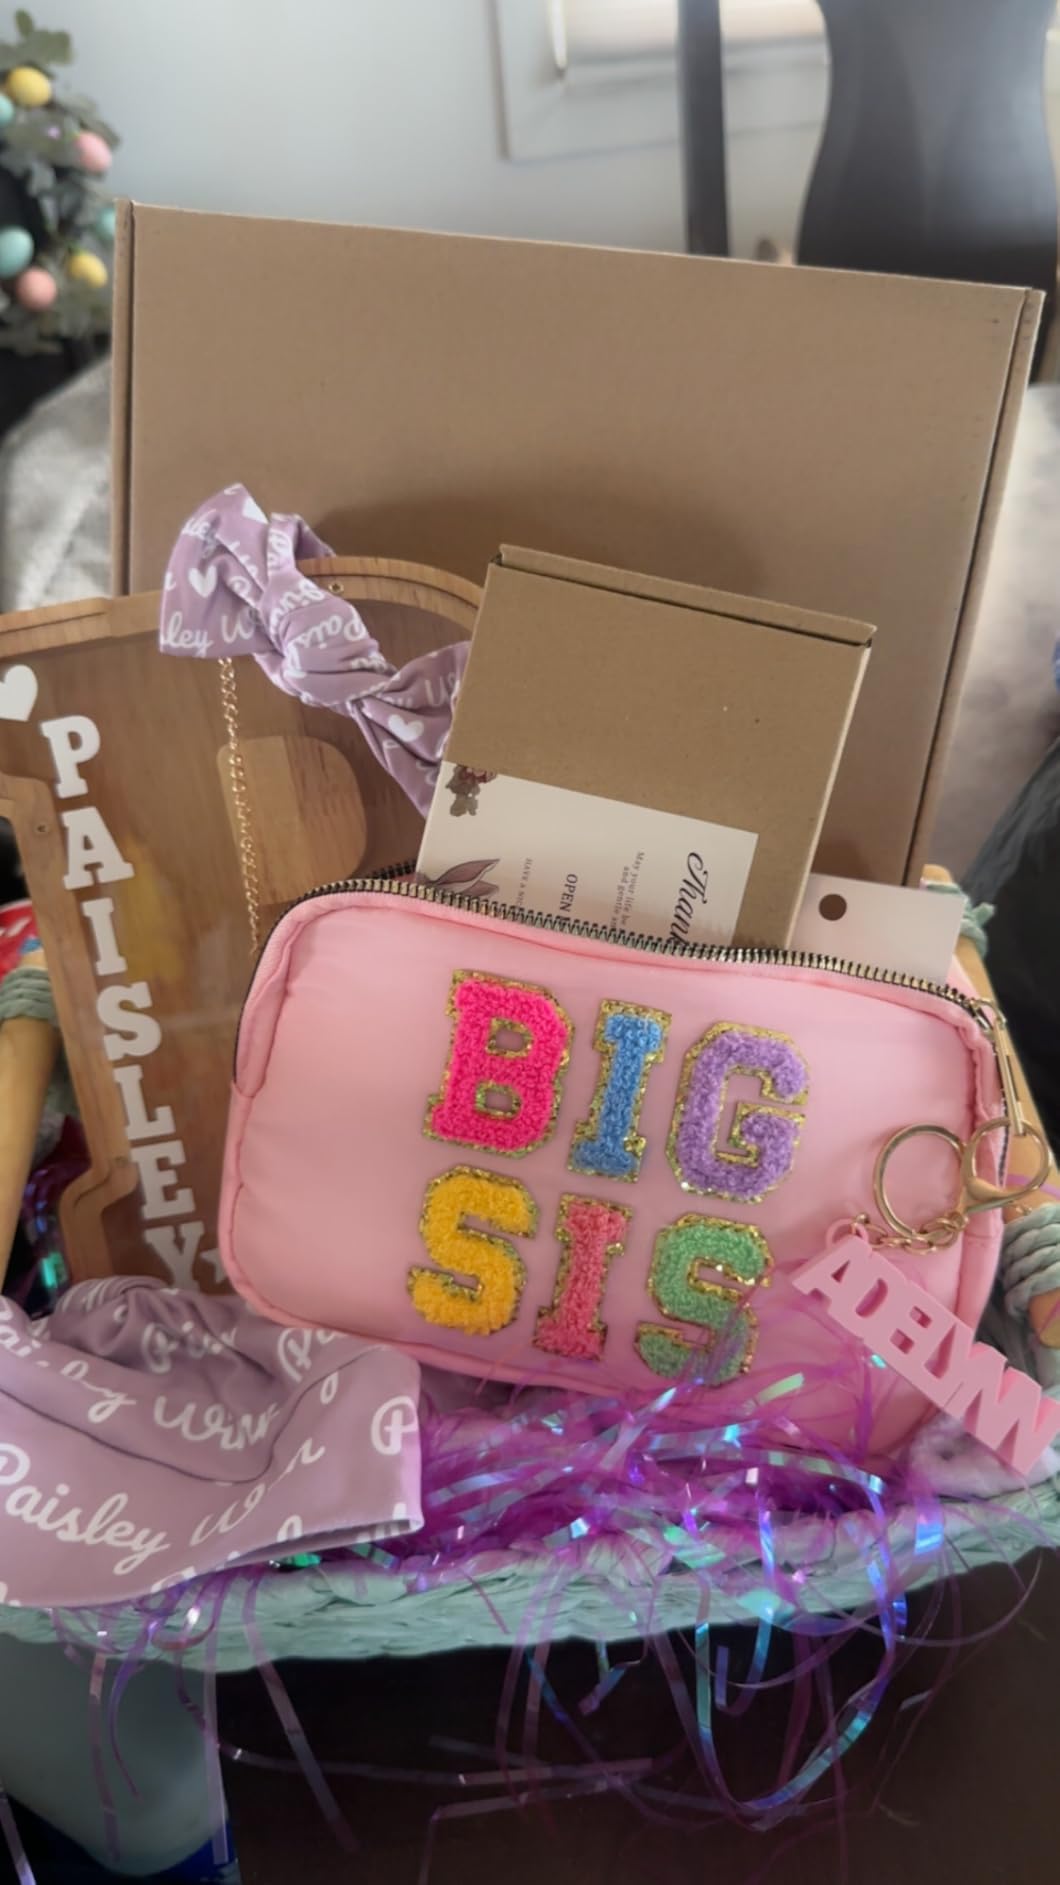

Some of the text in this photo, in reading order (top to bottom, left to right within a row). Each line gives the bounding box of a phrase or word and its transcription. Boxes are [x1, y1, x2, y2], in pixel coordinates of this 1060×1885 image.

[40, 714, 206, 1290] PAISLEY
[559, 873, 578, 913] OPEN
[423, 969, 809, 1205] BIG
[407, 1164, 775, 1388] SIS
